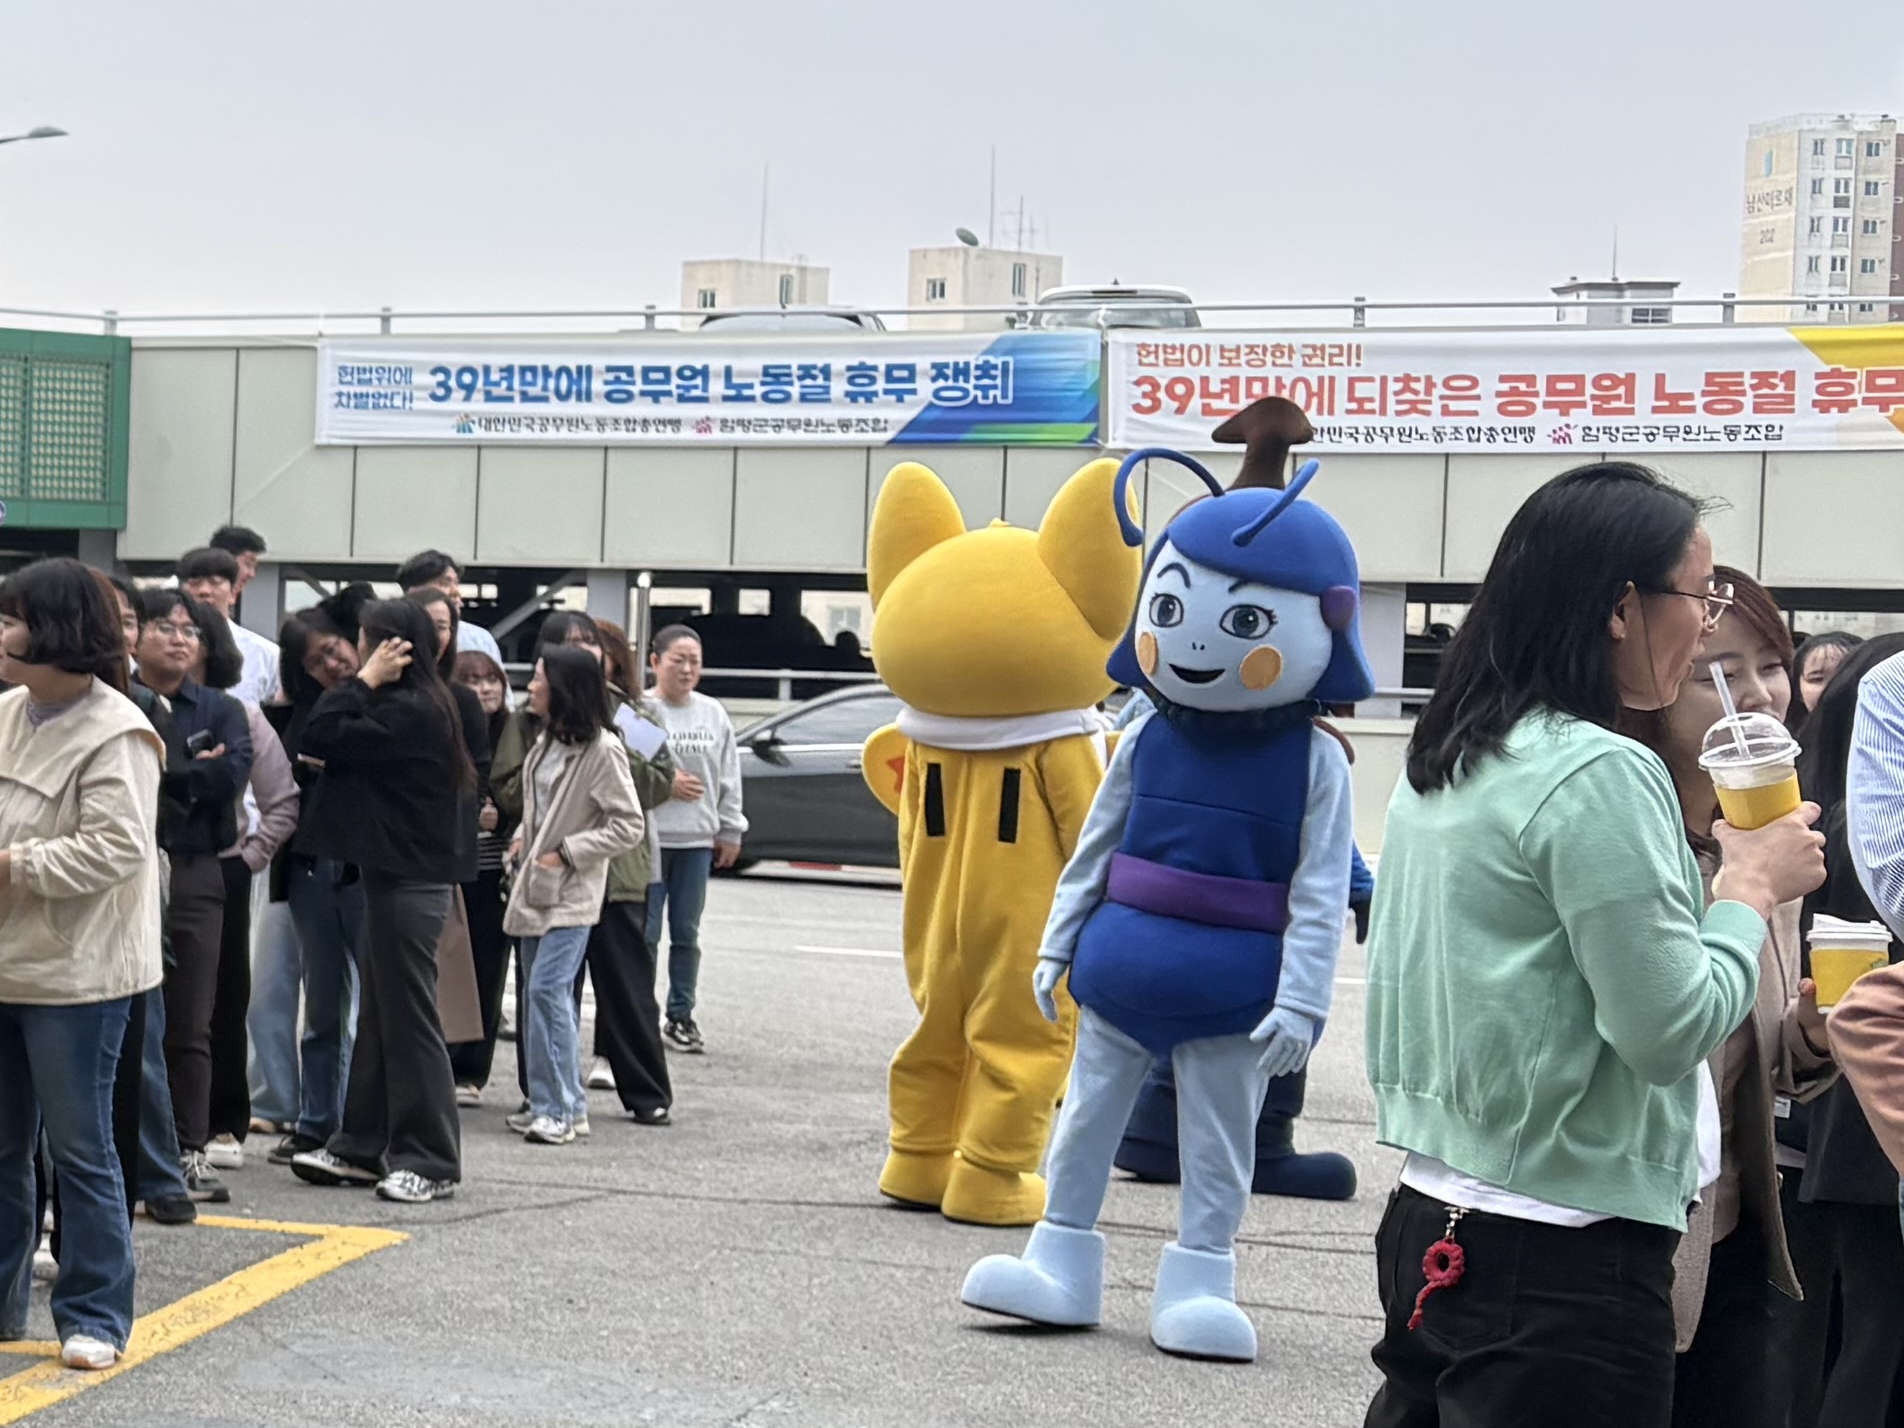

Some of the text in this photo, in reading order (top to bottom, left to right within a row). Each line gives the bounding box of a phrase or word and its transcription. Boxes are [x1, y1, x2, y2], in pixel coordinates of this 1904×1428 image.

[1136, 343, 1362, 368] 헌법이 보장한 권리!
[337, 363, 413, 386] 헌법위에
[428, 358, 1012, 405] 39년만에 공무원 노동절 휴무 쟁취
[334, 388, 414, 411] 차별없다!
[1345, 373, 1481, 417] 되찾은
[1495, 372, 1636, 417] 공무원
[1651, 370, 1796, 416] 노동절
[1812, 367, 1904, 414] 휴무
[1312, 424, 1536, 444] 한민국공무원노동조합총연맹
